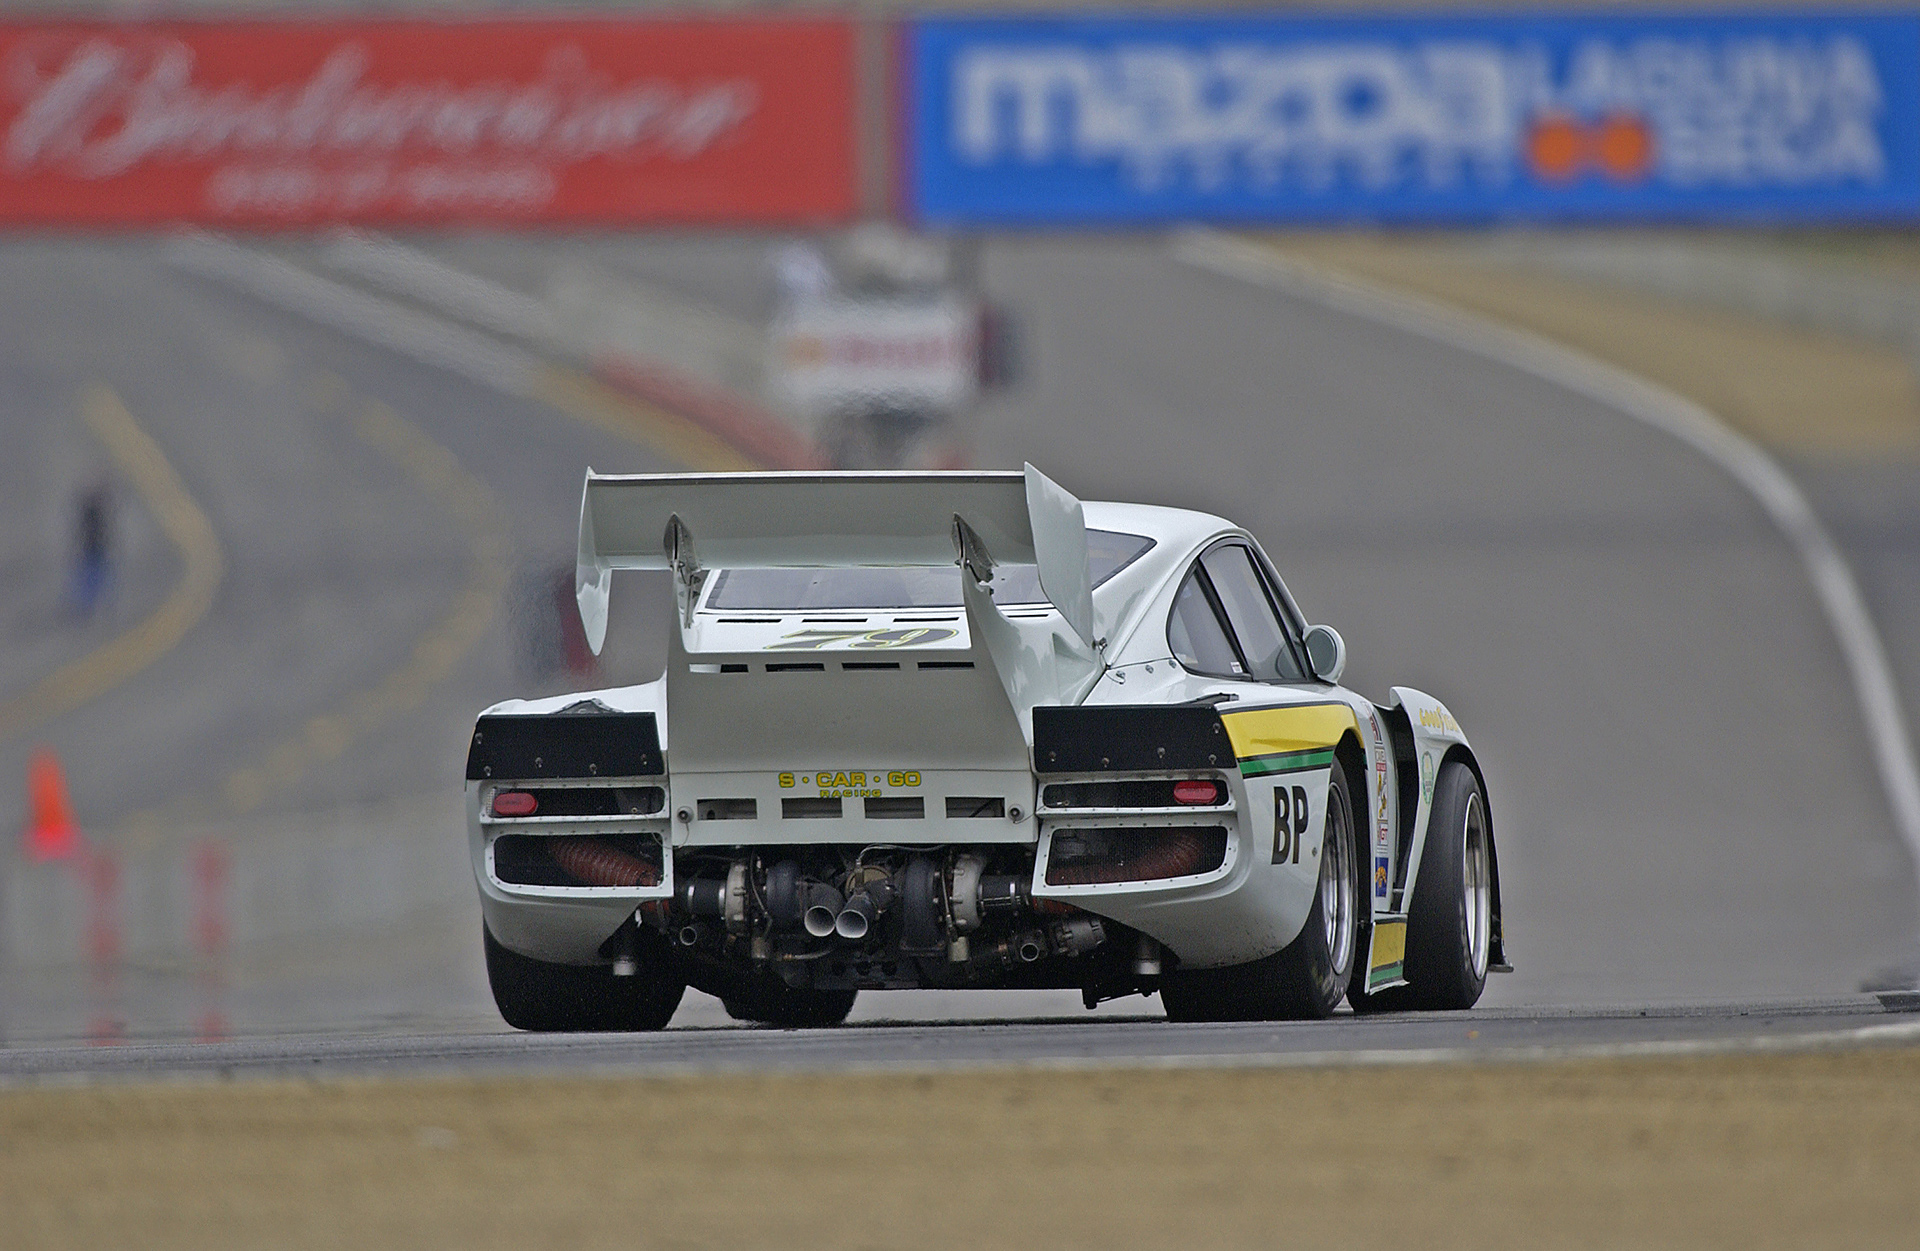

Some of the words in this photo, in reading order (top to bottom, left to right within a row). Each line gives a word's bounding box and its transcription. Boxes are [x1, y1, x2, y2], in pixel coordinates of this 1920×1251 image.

[1517, 38, 1882, 108] LAGUNA
[764, 628, 960, 649] 79
[819, 789, 882, 798] RACING
[1271, 786, 1309, 865] BP
